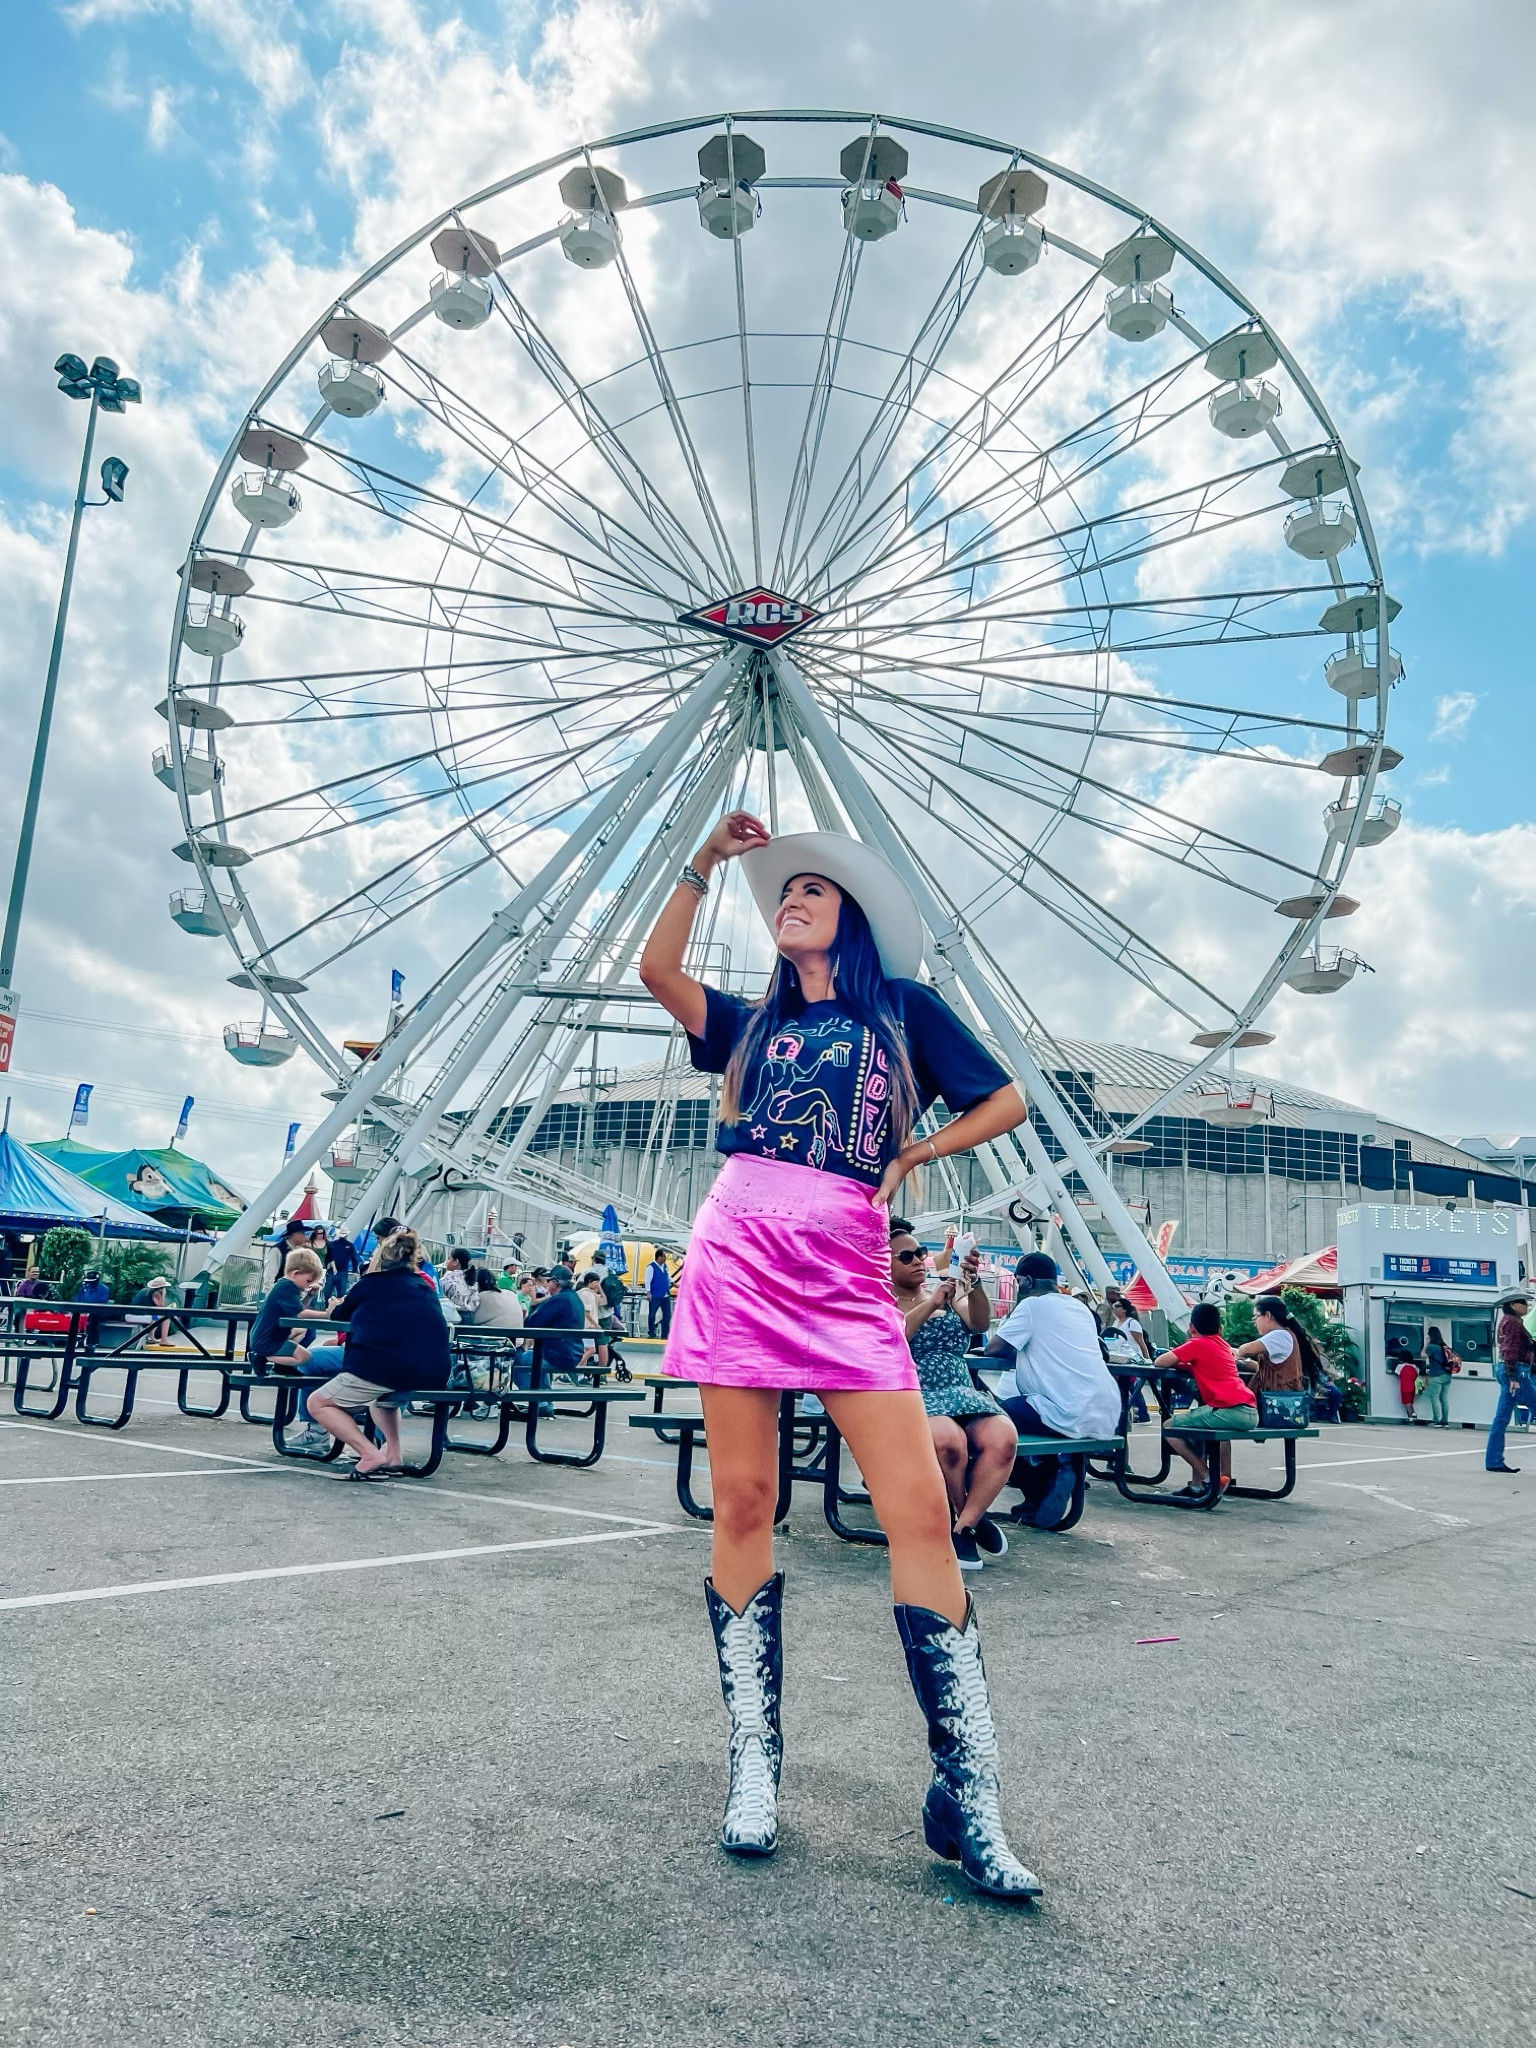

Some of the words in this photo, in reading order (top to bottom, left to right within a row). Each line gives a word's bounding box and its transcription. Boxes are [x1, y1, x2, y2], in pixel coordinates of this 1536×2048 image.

[725, 602, 803, 625] RCS
[1337, 1210, 1358, 1226] TICKETS
[1368, 1205, 1509, 1235] TICKETS
[1166, 1264, 1205, 1277] EXAS
